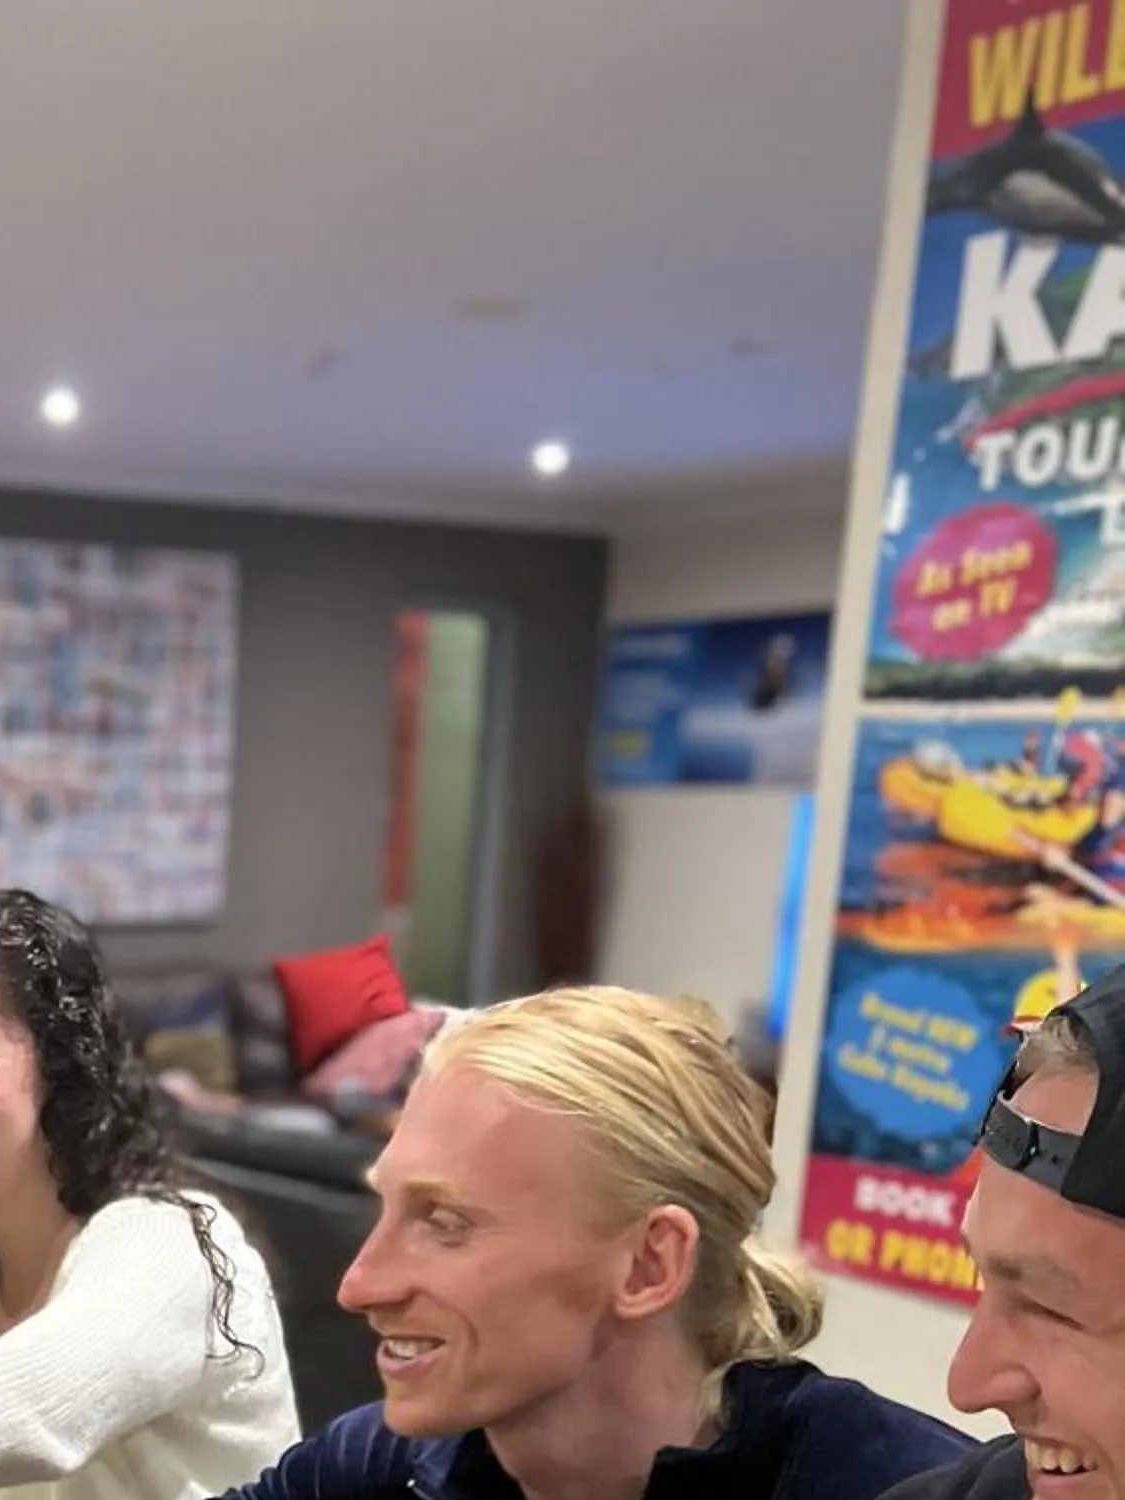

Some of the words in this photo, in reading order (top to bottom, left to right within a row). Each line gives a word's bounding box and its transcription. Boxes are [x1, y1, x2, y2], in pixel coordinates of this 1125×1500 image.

[973, 416, 1125, 491] TOU
[978, 576, 1018, 618] TV
[855, 1174, 955, 1228] BOOK
[827, 1217, 873, 1265] OR
